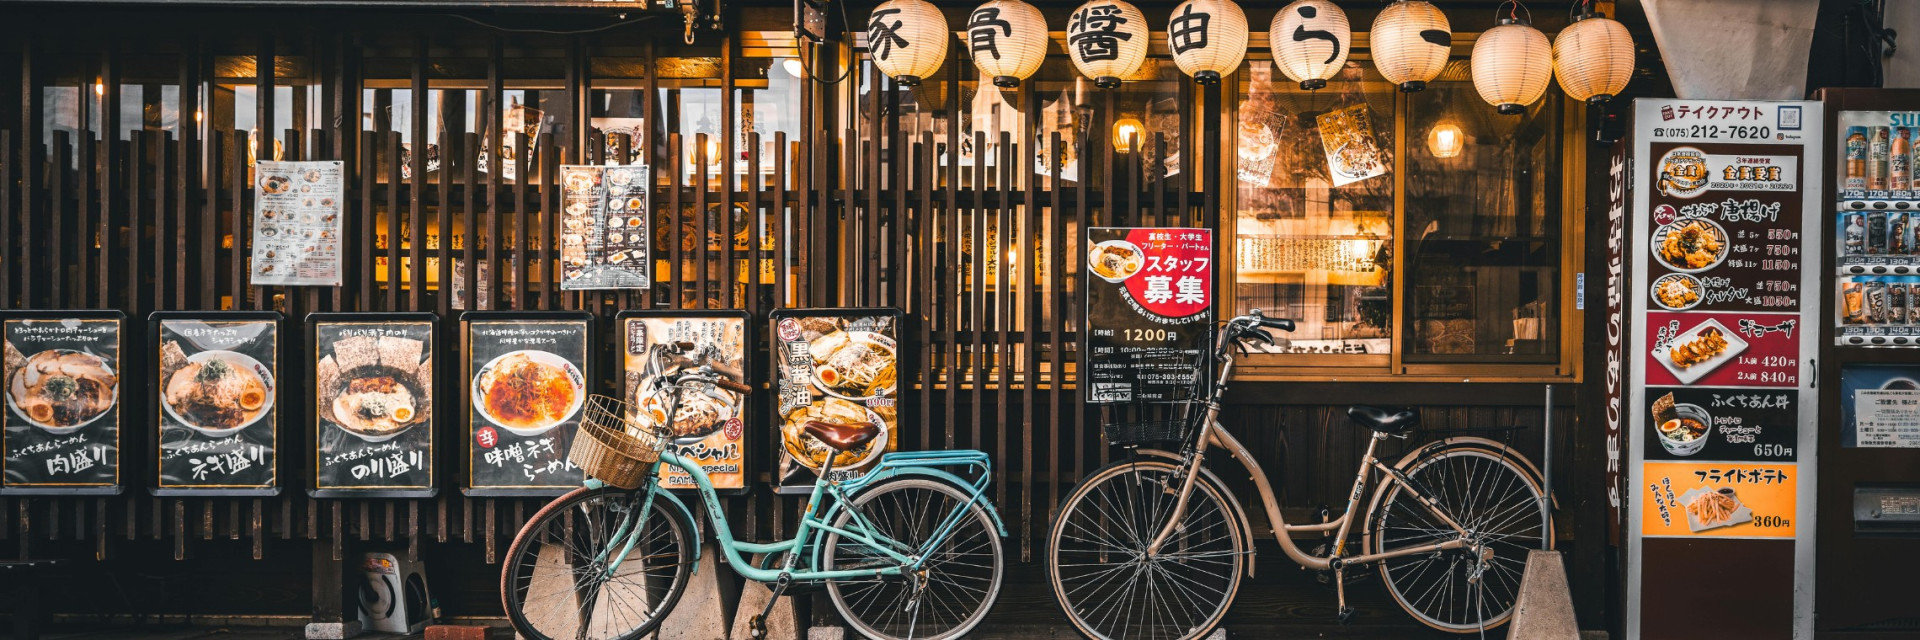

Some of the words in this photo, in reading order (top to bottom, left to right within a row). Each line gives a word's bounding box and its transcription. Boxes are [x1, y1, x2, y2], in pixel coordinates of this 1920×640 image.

[1293, 6, 1340, 64] ら
[1678, 105, 1764, 120] テイクアウト
[1723, 165, 1782, 181] 金賞受賞
[1680, 203, 1719, 218] やわらか
[1720, 198, 1781, 222] 唐揚げ
[1149, 233, 1203, 241] 高校生・大学生
[1146, 256, 1209, 272] スタッフ
[1144, 275, 1204, 304] 募集
[1706, 286, 1749, 305] タルタル
[1873, 292, 1885, 320] BOSS
[1124, 329, 1177, 341] 1200円
[1739, 319, 1796, 339] ギョーザ
[1607, 155, 1623, 525] お持帰りあります
[1738, 356, 1758, 365] 1人前
[1761, 356, 1796, 367] 420円
[790, 341, 812, 407] 黒醤油
[1737, 372, 1757, 380] 2人前
[1760, 372, 1795, 383] 840円
[1711, 394, 1790, 409] ふくちあん丼
[12, 433, 88, 459] ふくちあんらーめん
[166, 434, 244, 459] ふくちあんらーめん
[479, 429, 494, 447] 辛
[325, 441, 400, 466] ふくちあんらーめん
[484, 436, 555, 468] 味噌ネギ
[1754, 443, 1792, 457] 650円
[46, 446, 107, 475] 肉盛り
[189, 445, 264, 481] ネギ盛り
[350, 450, 423, 479] のり盛り
[523, 457, 578, 481] らーめん
[702, 464, 738, 474] special
[1695, 469, 1788, 484] フライドポテト
[1754, 515, 1790, 528] 360円
